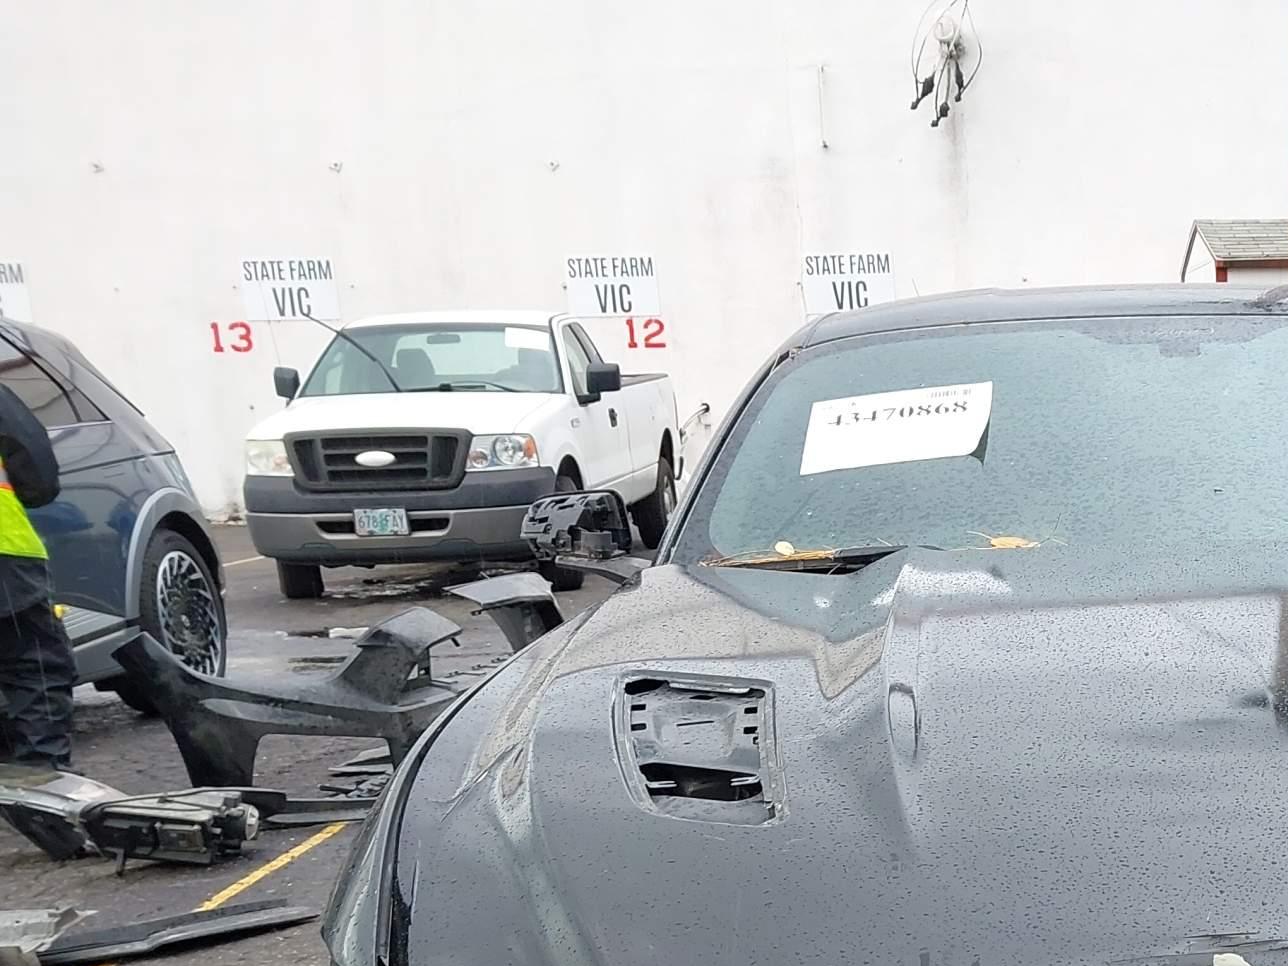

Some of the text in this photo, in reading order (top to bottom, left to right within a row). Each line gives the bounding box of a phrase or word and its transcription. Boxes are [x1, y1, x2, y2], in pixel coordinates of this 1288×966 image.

[242, 260, 332, 281] STATE FARM
[567, 257, 653, 278] STATE FARM
[805, 253, 890, 276] STATE FARM
[272, 286, 311, 317] VIC
[594, 283, 632, 313] VIC
[832, 280, 868, 310] VIC
[210, 321, 253, 352] 13
[625, 319, 666, 348] 12
[827, 400, 969, 427] 43470868
